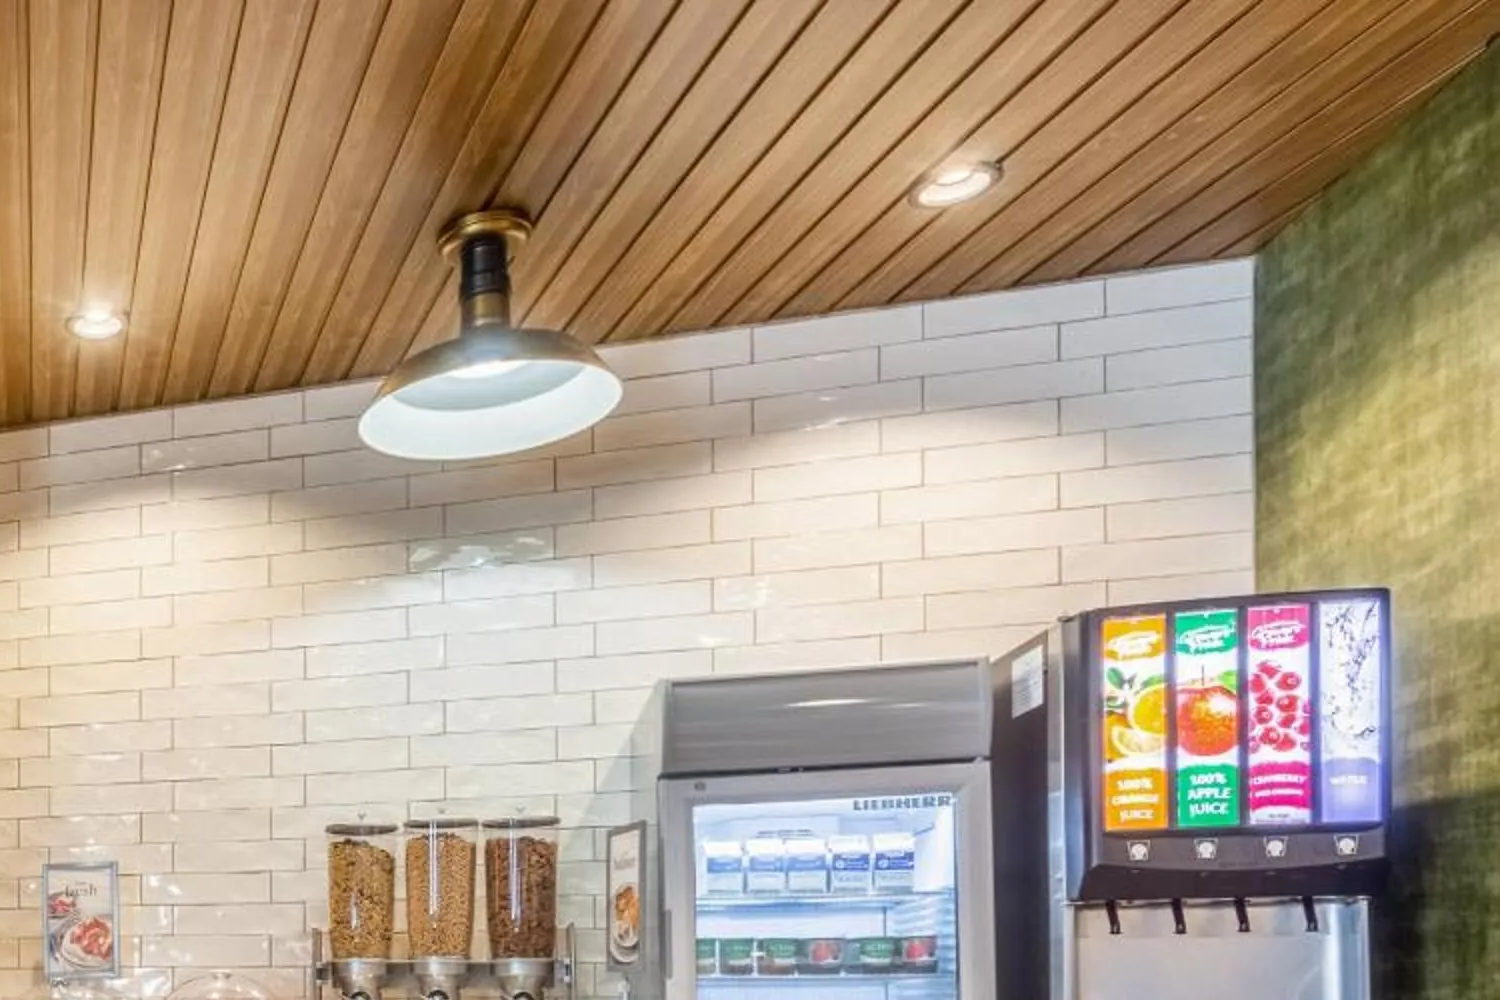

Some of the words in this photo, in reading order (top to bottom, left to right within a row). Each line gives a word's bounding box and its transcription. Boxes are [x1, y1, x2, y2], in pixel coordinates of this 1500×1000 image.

[1187, 787, 1231, 801] APPLE
[1119, 808, 1155, 823] JUICE
[1188, 801, 1229, 818] JUICE
